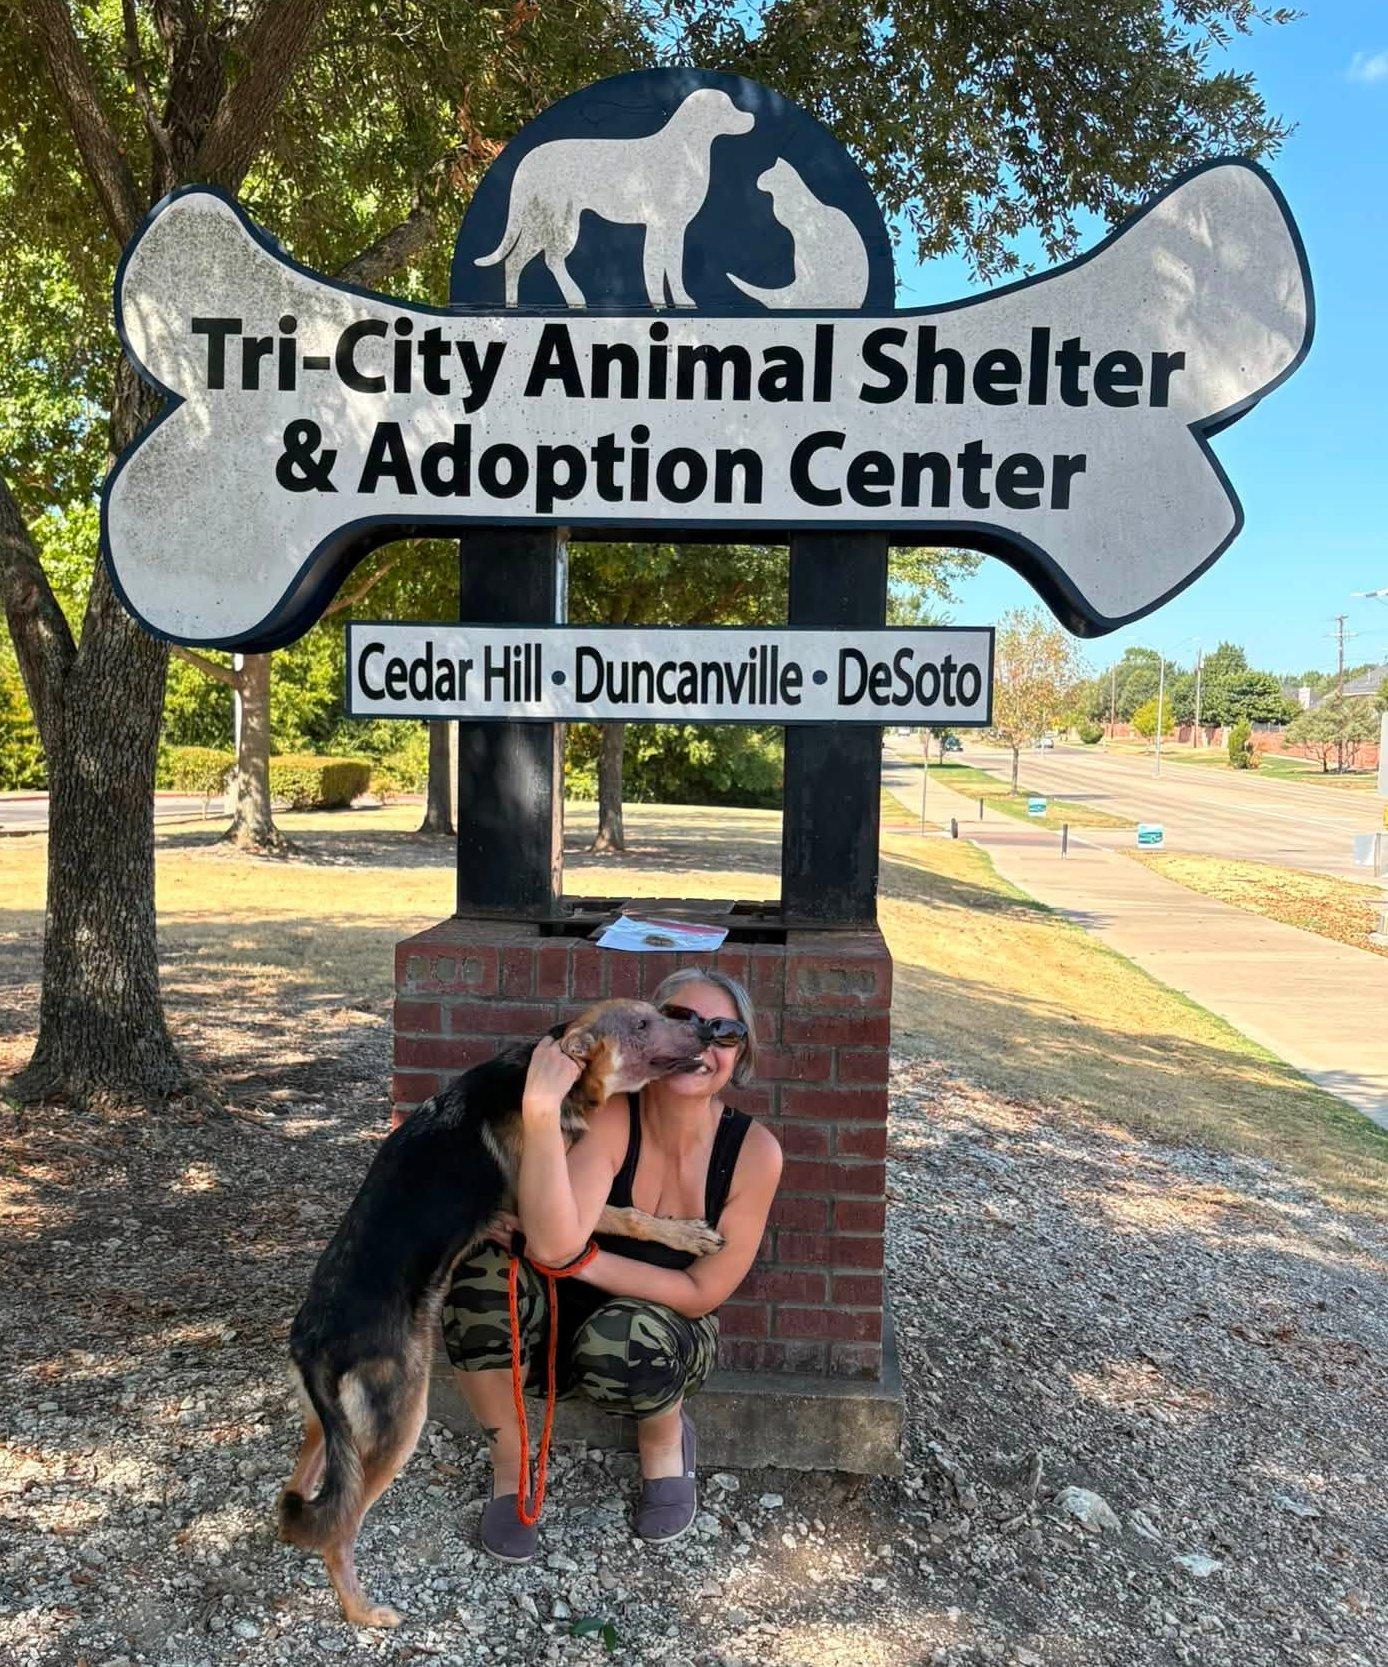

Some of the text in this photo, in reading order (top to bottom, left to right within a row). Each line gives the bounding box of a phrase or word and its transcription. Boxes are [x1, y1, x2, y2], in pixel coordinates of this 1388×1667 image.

[191, 314, 1186, 414] Tri-City Animal Shelter
[275, 418, 1087, 514] & Adoption Center
[357, 641, 982, 707] Cedar Hill Duncanville DeSoto
